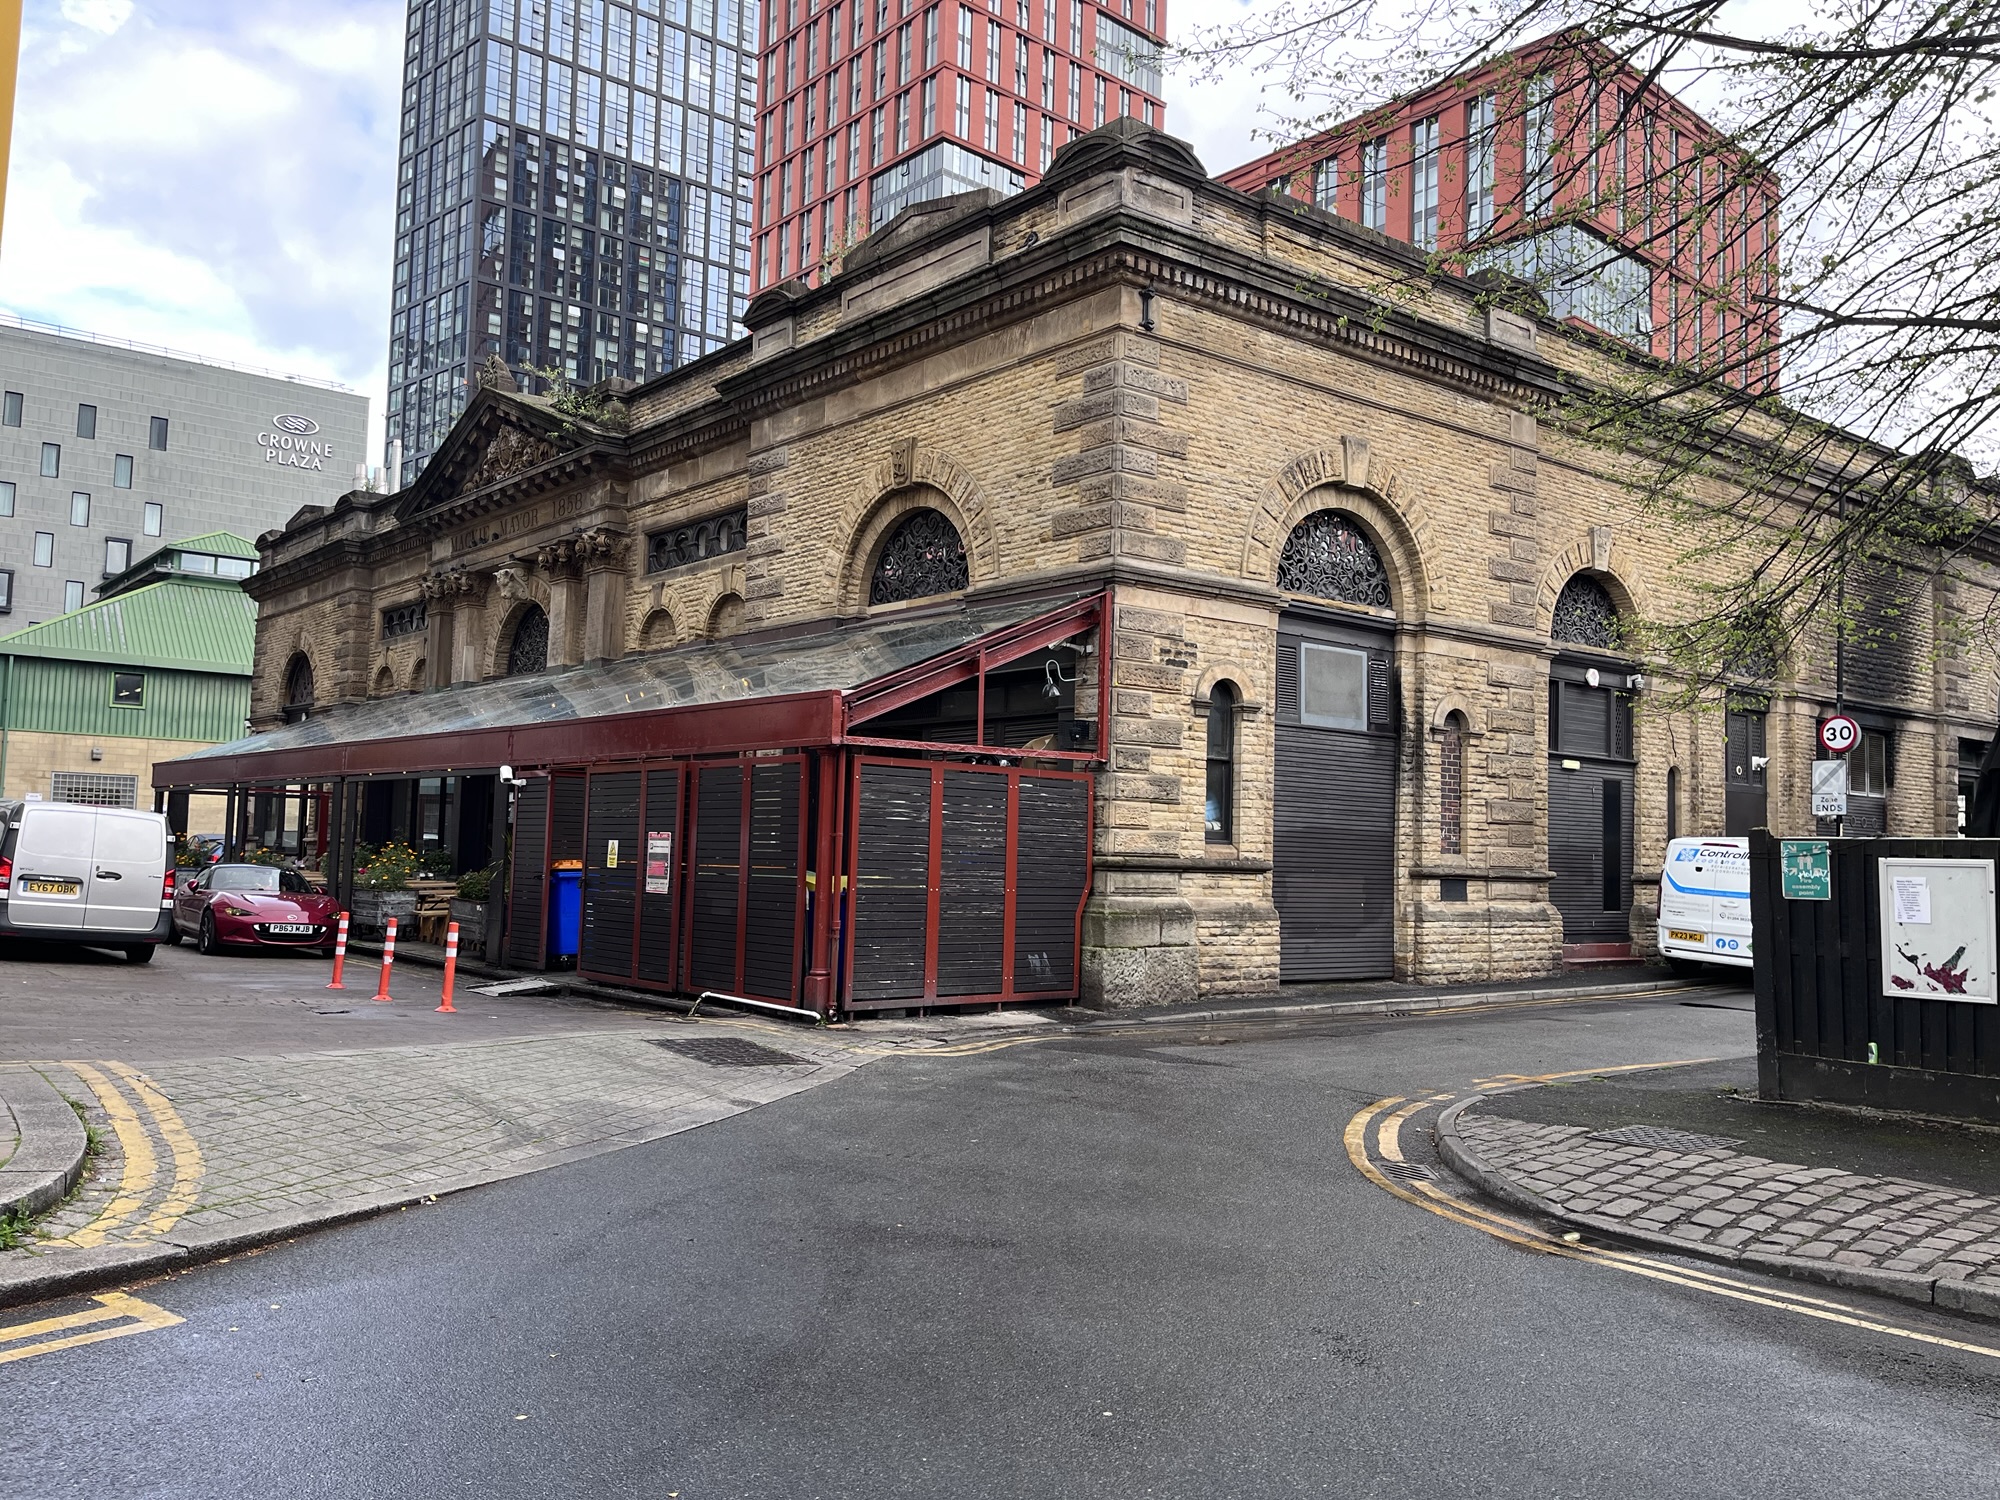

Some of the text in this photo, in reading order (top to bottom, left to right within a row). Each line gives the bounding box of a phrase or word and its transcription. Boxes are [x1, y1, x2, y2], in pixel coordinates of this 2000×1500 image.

[257, 432, 333, 457] CROWNE
[266, 448, 322, 471] PLAZA
[500, 508, 539, 536] MAYOR
[552, 492, 583, 519] 1858
[1825, 725, 1852, 742] 30
[1815, 804, 1843, 812] ENDS
[30, 882, 55, 892] EY67
